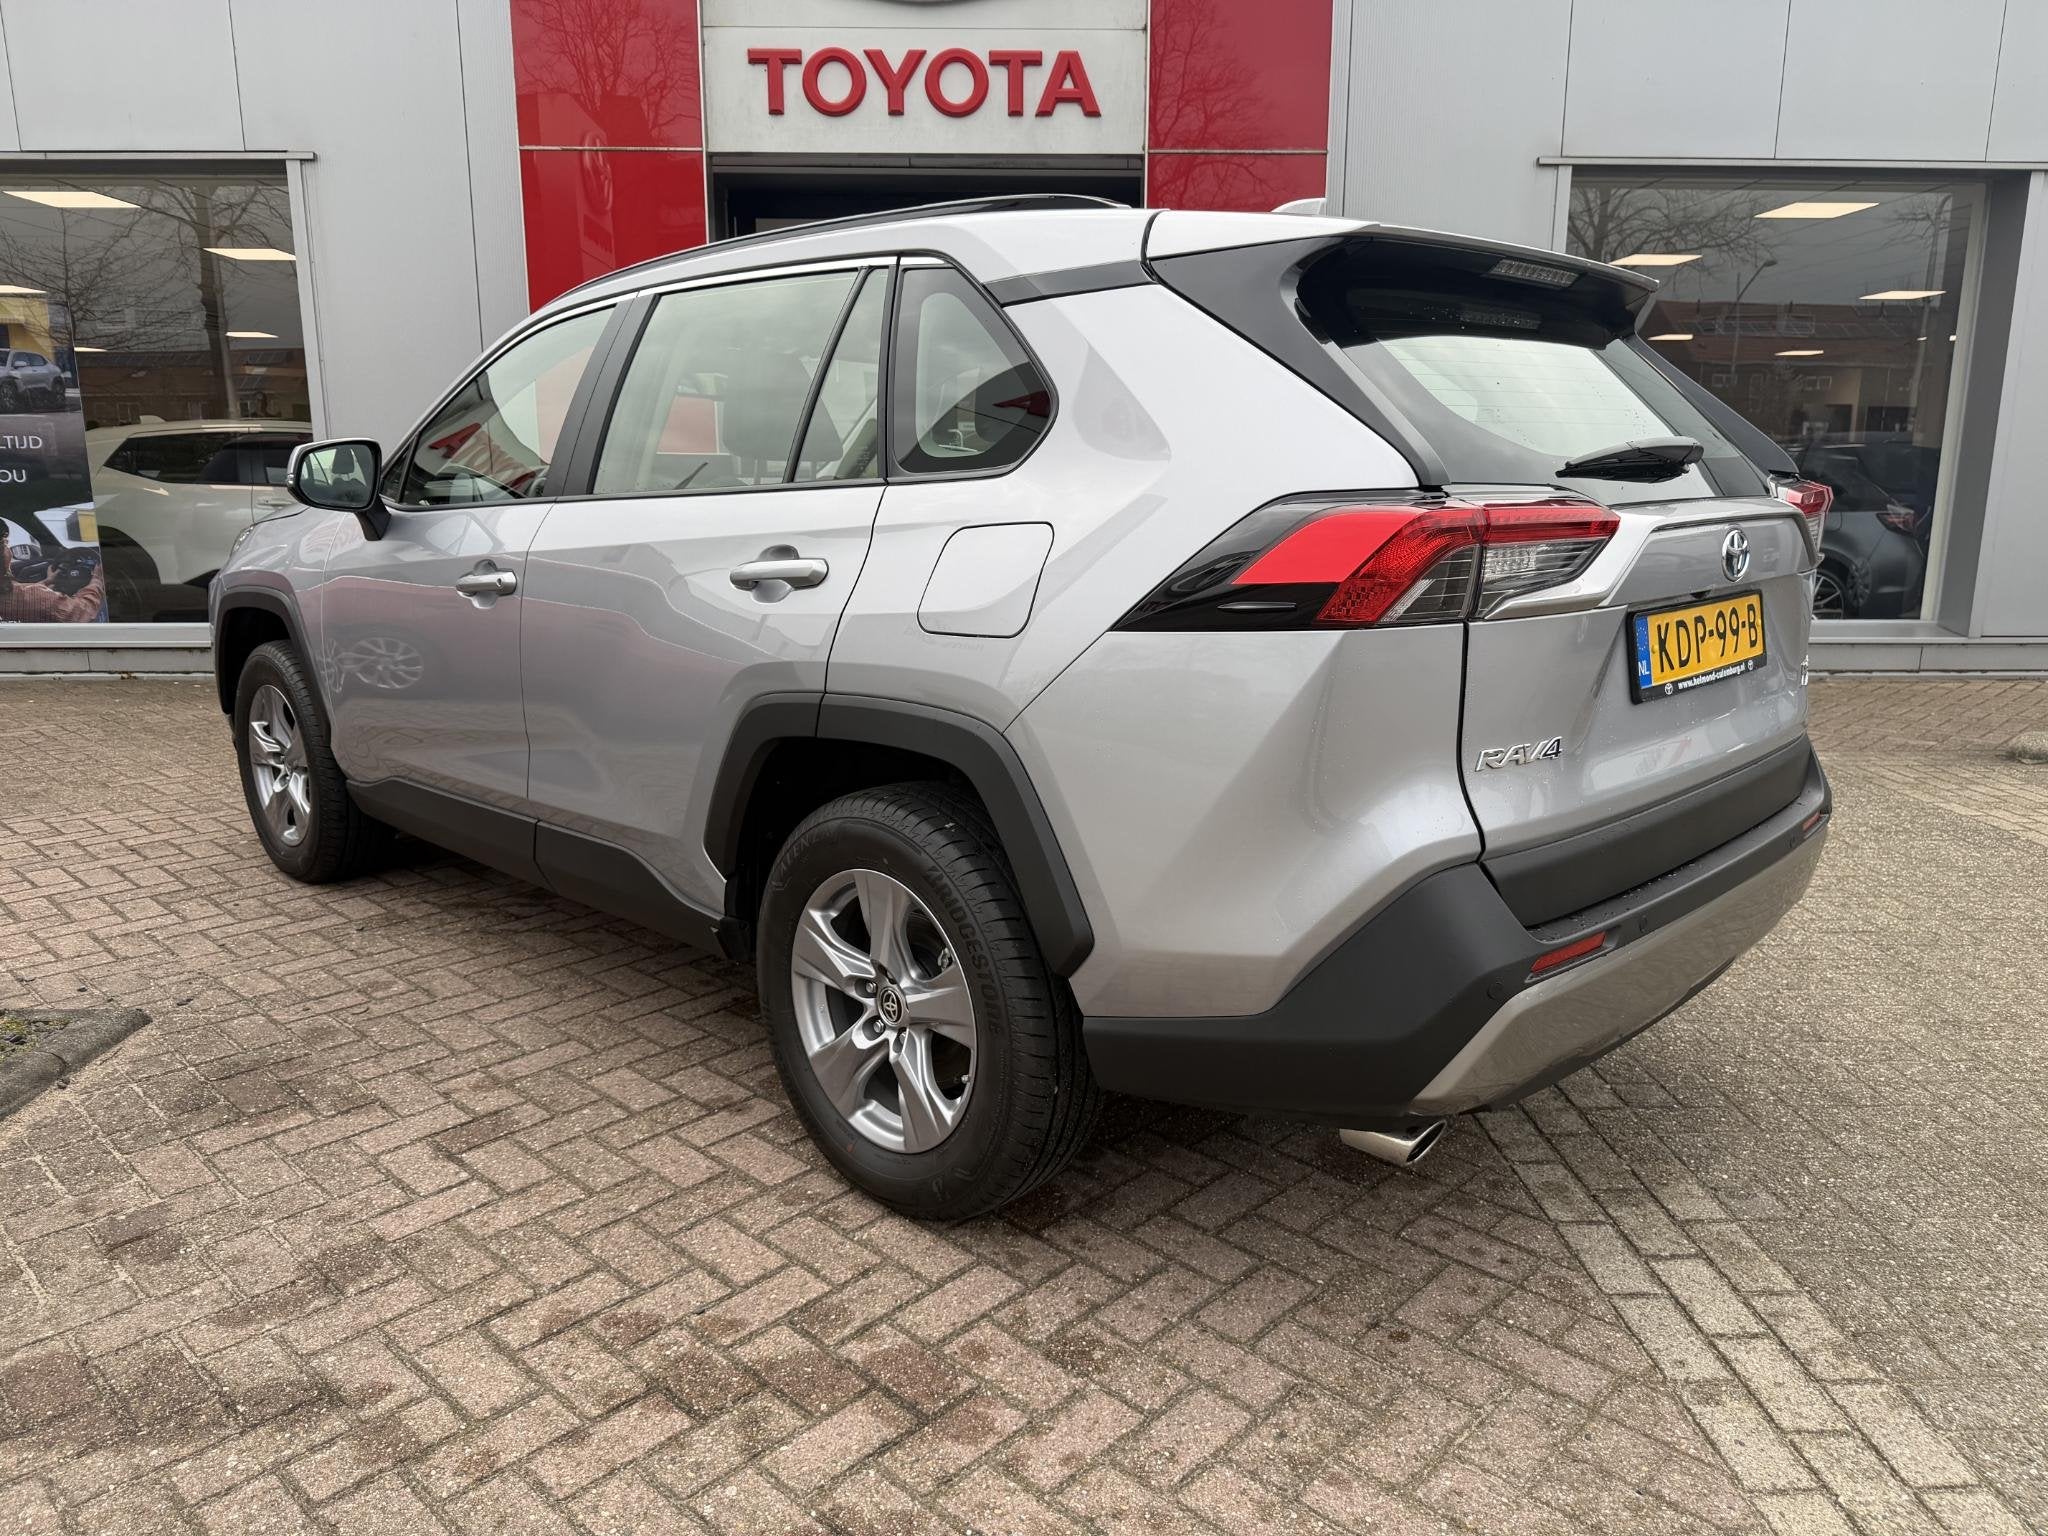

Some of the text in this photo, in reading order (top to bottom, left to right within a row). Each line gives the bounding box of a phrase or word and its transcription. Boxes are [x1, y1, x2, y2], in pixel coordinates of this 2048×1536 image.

[747, 46, 1101, 118] TOYOTA
[1656, 603, 1758, 673] KDP-99-B
[1638, 661, 1650, 677] NL
[1475, 736, 1562, 772] RAV4
